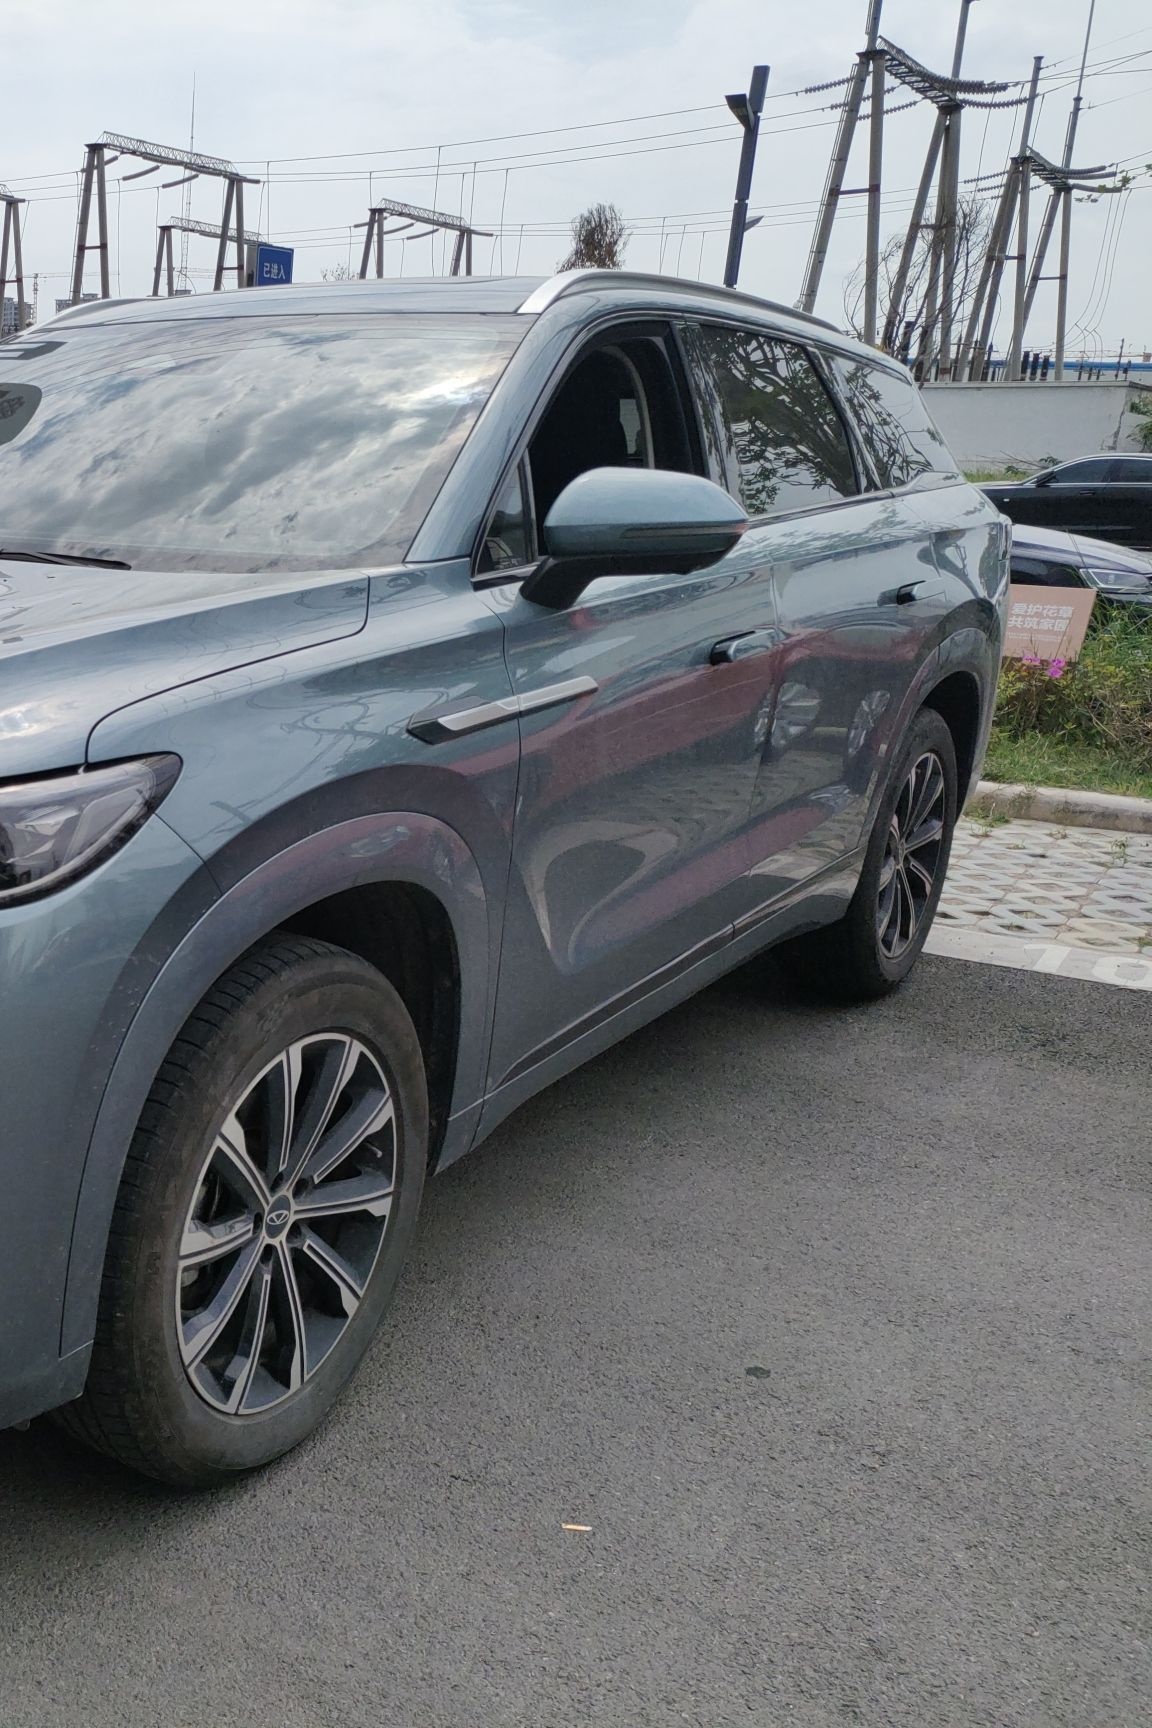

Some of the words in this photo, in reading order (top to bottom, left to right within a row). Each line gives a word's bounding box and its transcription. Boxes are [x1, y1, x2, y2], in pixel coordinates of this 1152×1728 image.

[1011, 602, 1074, 619] 爱护花草
[1007, 615, 1070, 632] 共筑家园
